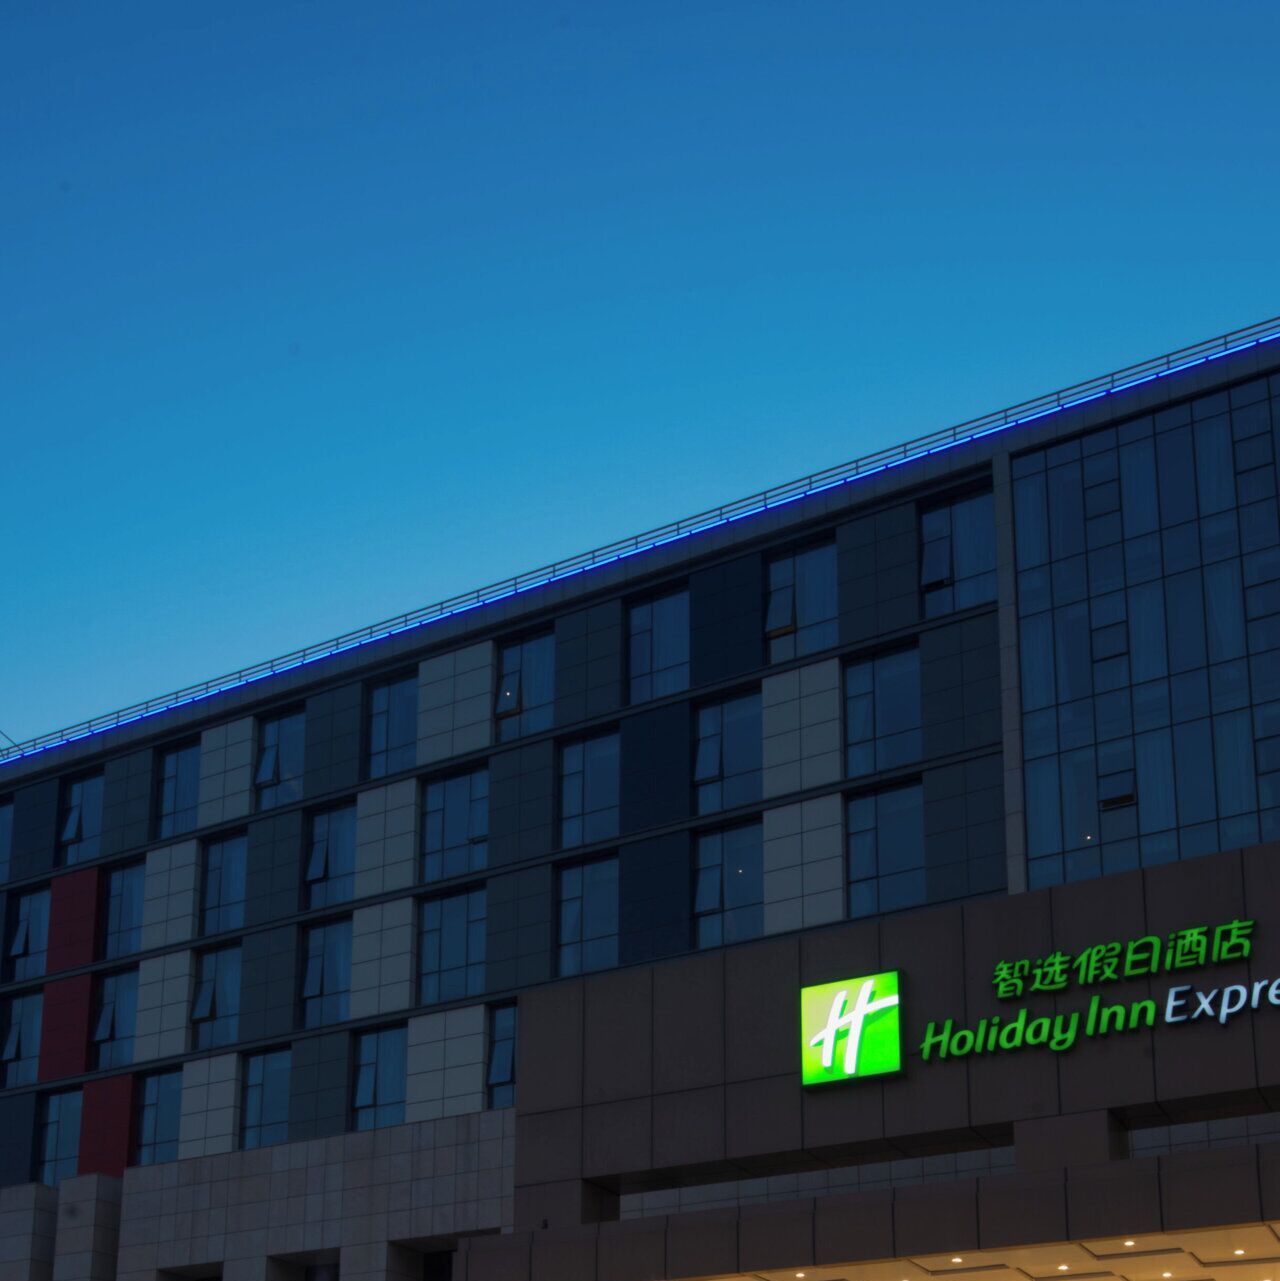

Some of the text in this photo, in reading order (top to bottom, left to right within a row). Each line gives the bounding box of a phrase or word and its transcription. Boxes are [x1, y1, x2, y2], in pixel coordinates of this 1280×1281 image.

[992, 919, 1256, 1000] 智选假日酒店
[920, 1008, 1079, 1062] Holiday
[1085, 995, 1157, 1036] Inn
